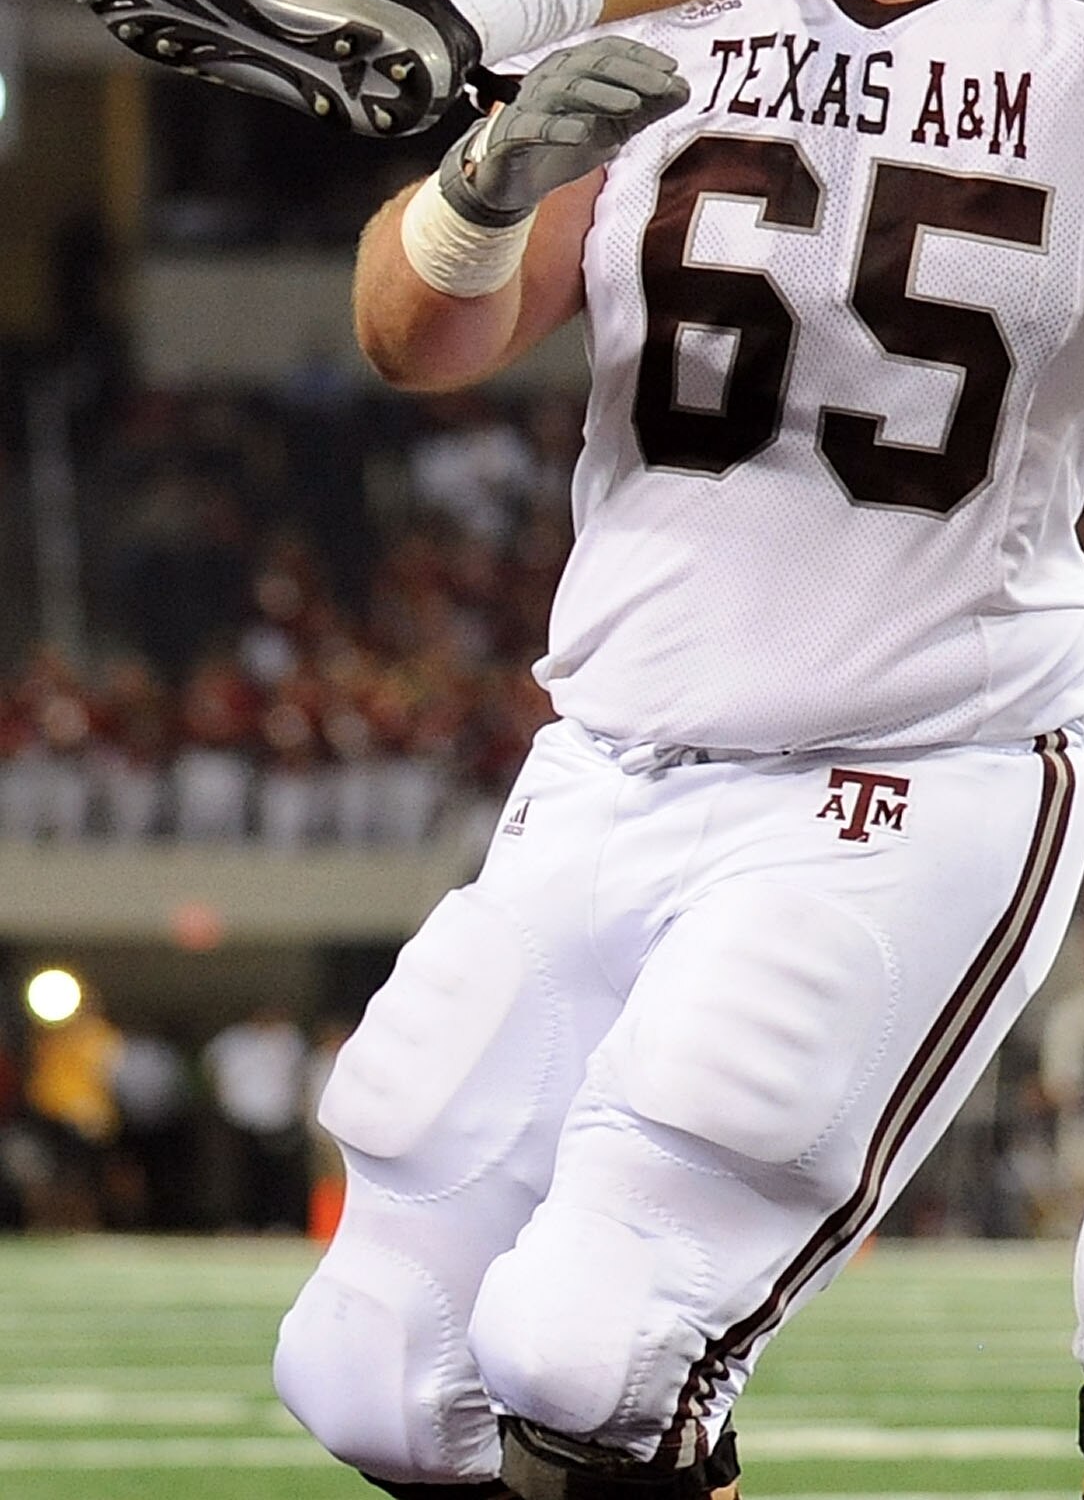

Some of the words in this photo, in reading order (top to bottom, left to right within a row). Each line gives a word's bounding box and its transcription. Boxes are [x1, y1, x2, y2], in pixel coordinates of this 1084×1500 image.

[699, 32, 893, 135] TEXAS
[911, 60, 1031, 159] A&M
[631, 130, 1056, 521] 65
